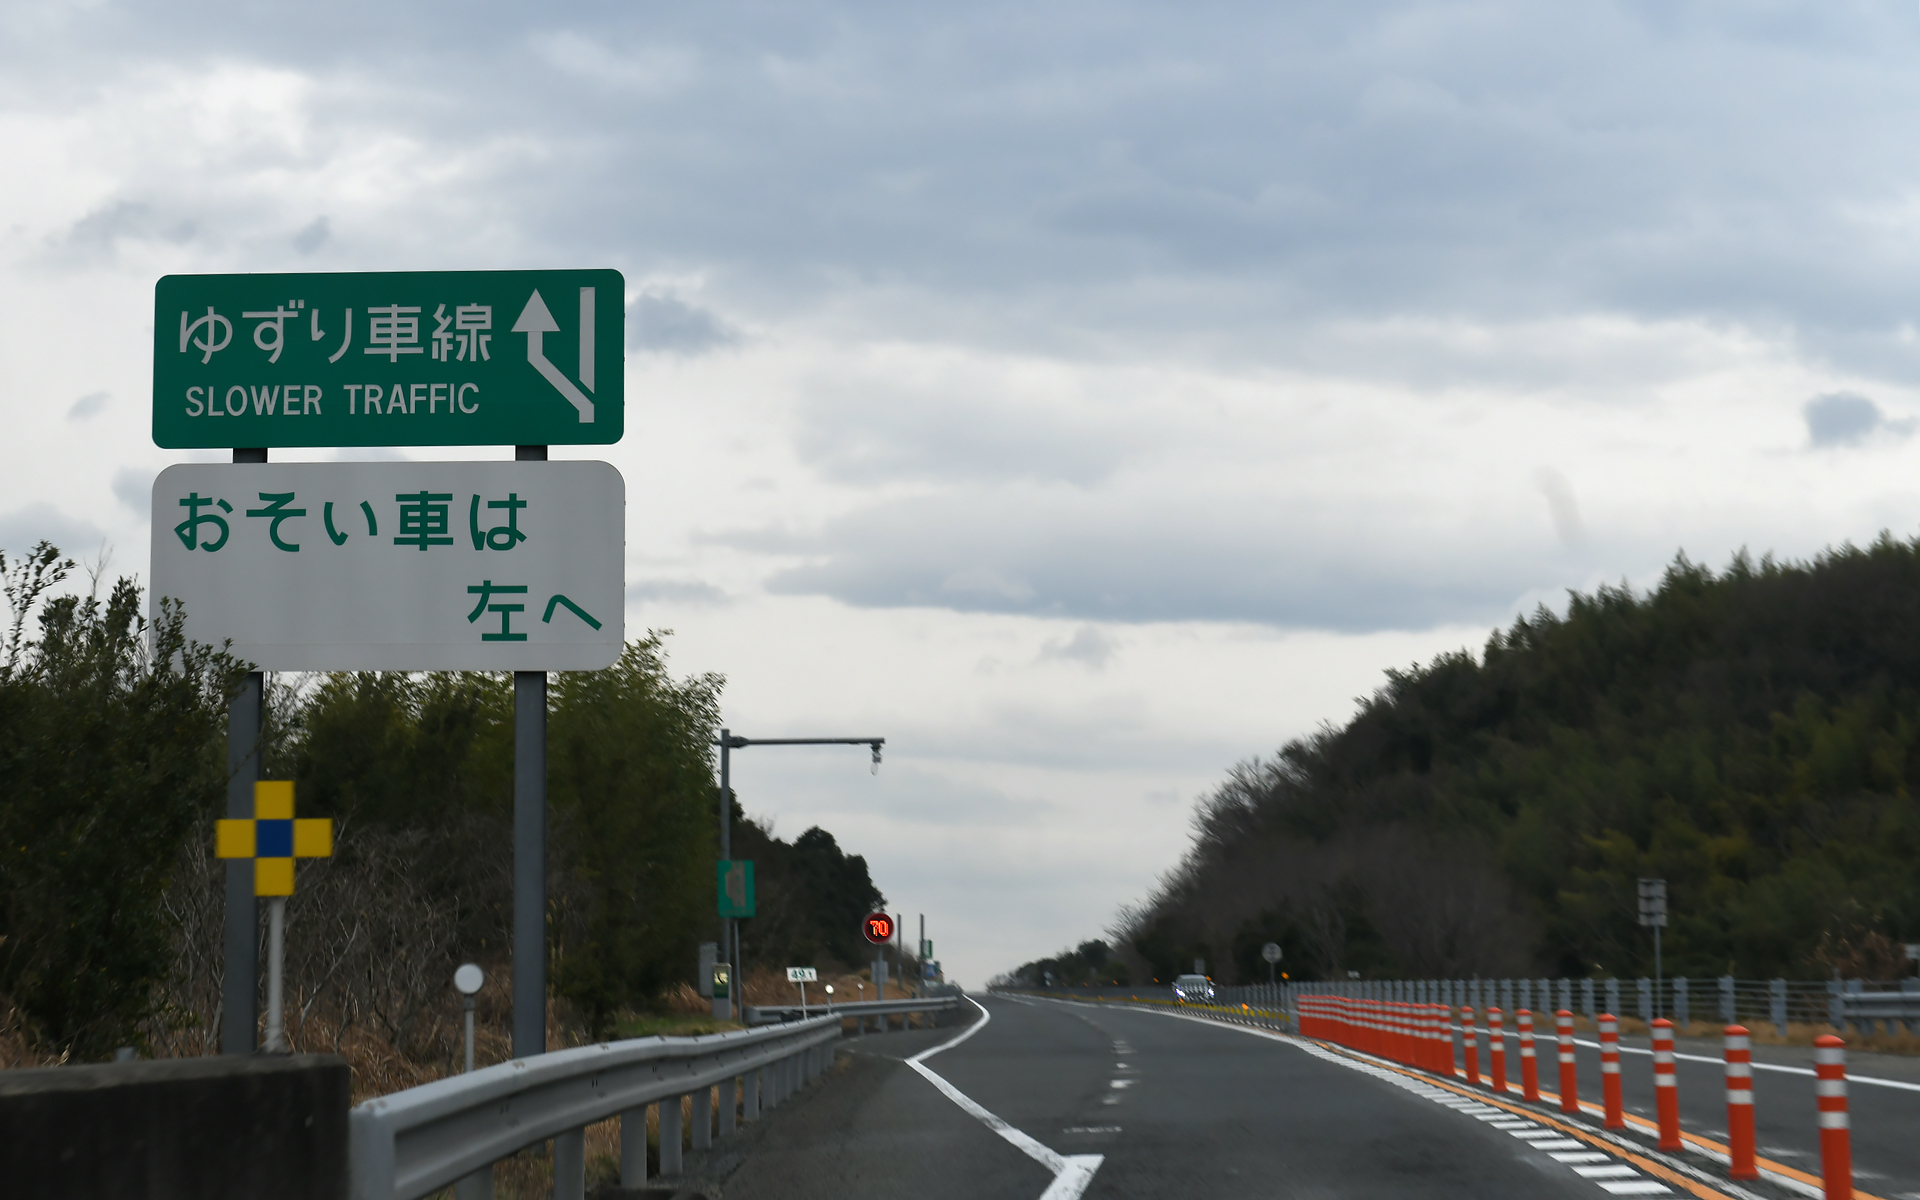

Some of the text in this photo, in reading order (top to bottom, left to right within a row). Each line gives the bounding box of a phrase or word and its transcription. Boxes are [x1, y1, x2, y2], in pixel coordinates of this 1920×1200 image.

[179, 299, 493, 364] ゆずり車線
[185, 382, 480, 417] SLOWER TRAFFIC
[174, 490, 528, 552] おそい車は
[467, 580, 602, 641] 左へ
[870, 920, 889, 937] 70
